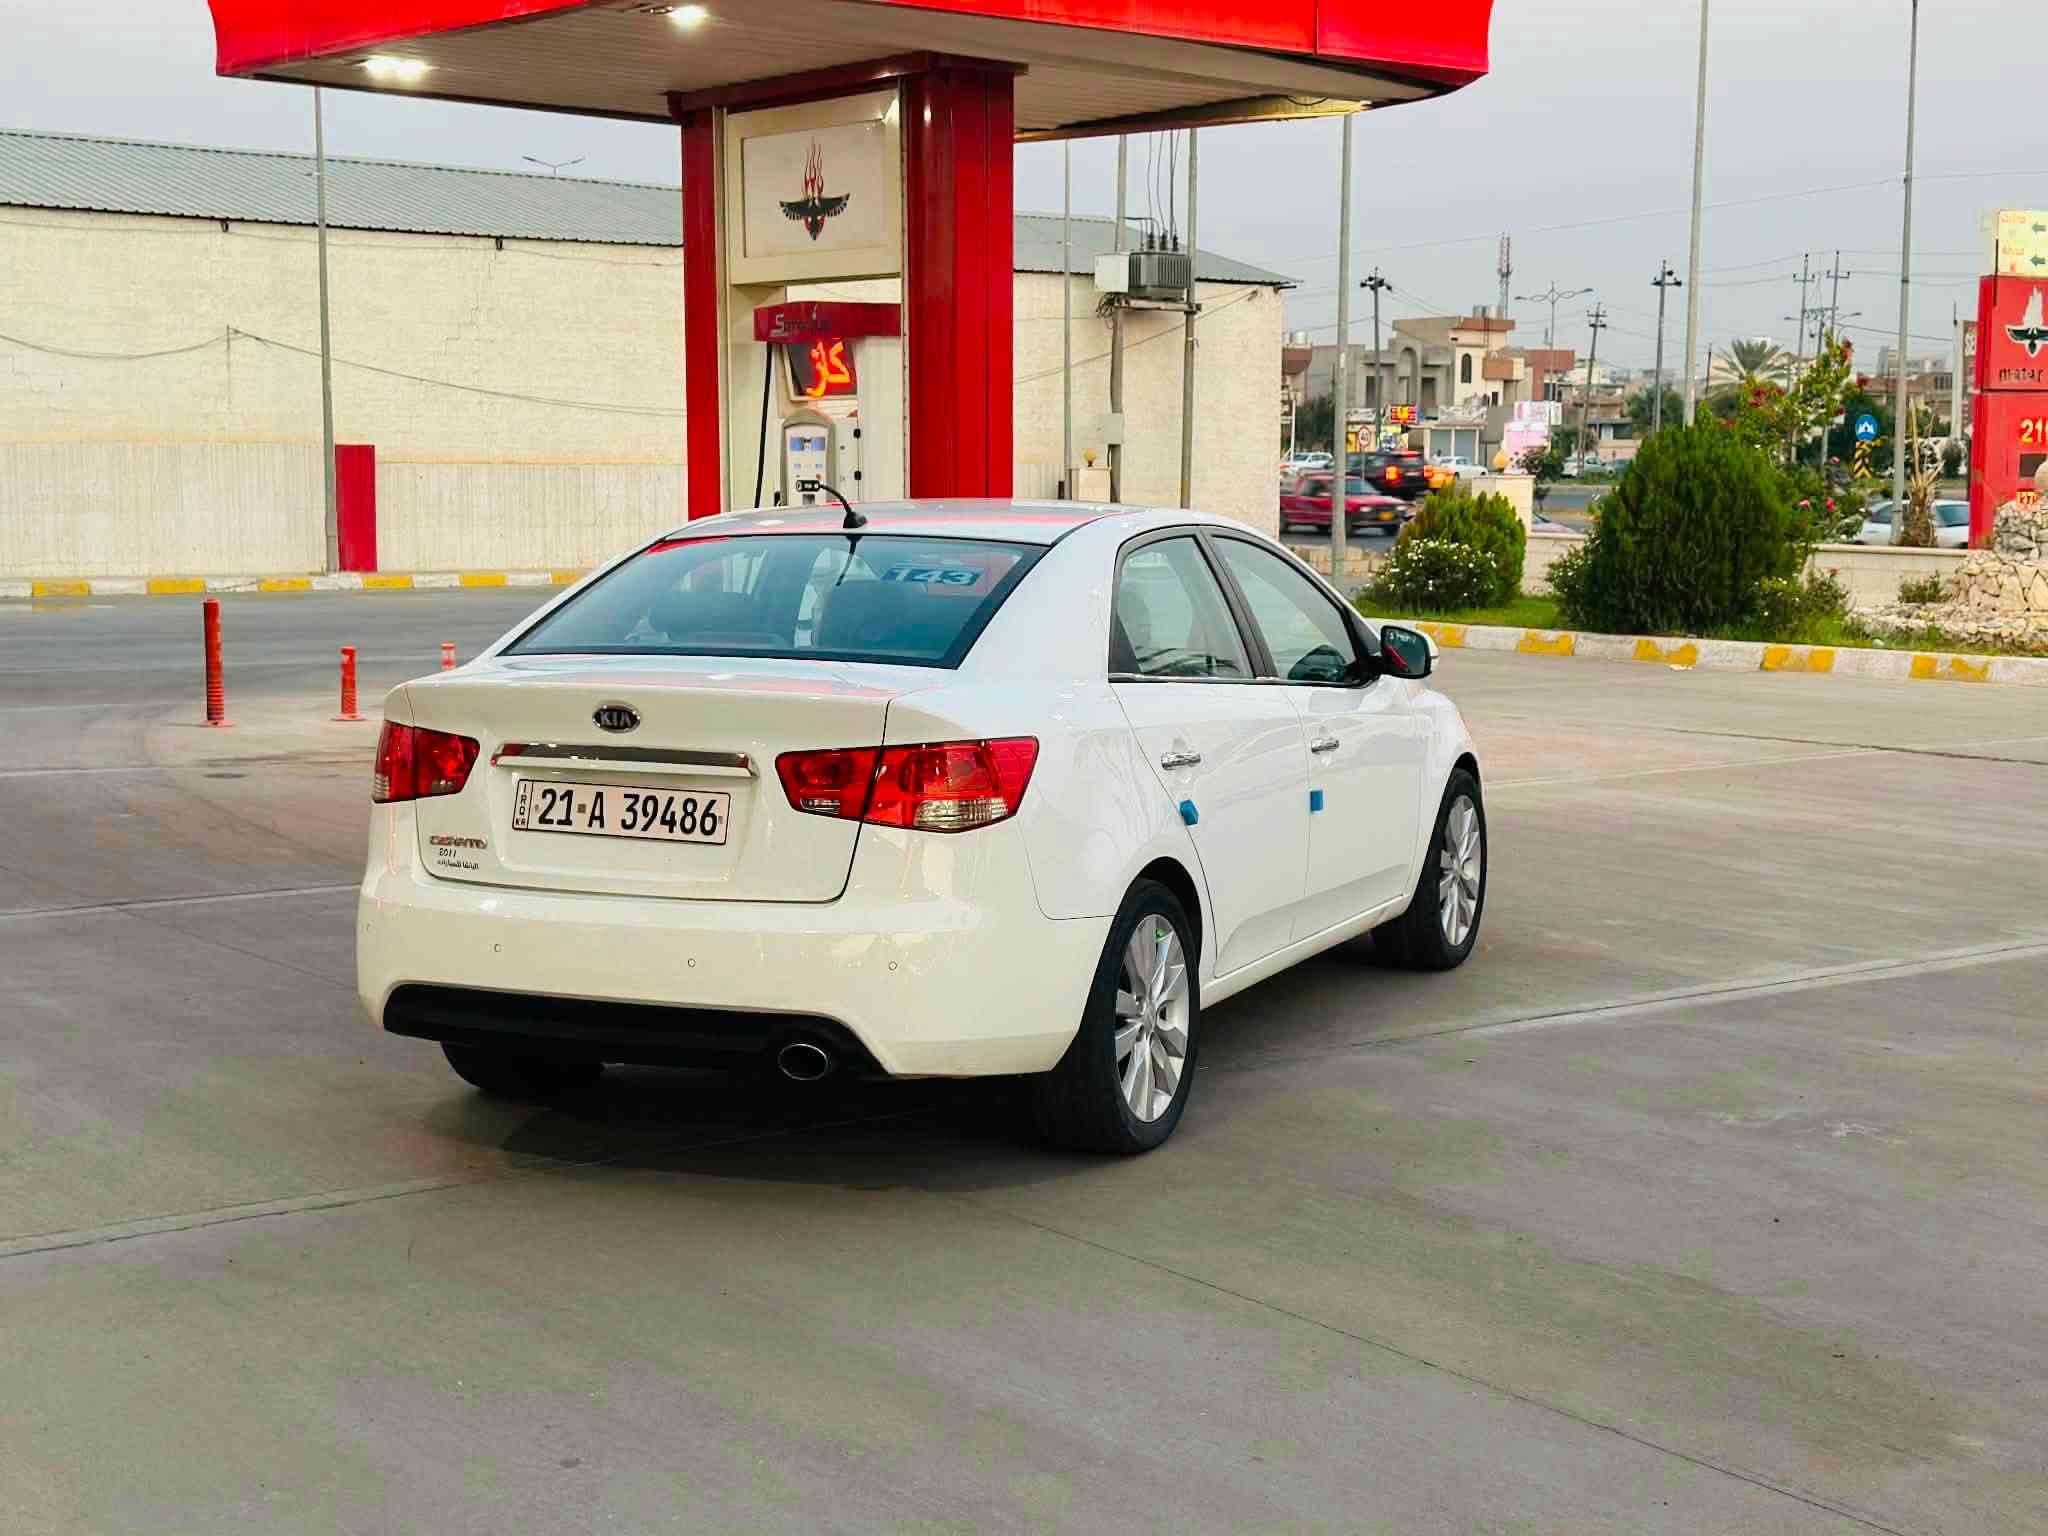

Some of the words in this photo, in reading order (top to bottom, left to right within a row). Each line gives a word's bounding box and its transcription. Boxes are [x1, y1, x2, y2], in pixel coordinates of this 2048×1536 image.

[2020, 416, 2048, 444] 21
[600, 711, 631, 727] KIA
[538, 788, 574, 826] 21
[587, 791, 605, 829] A
[620, 793, 718, 837] 39486
